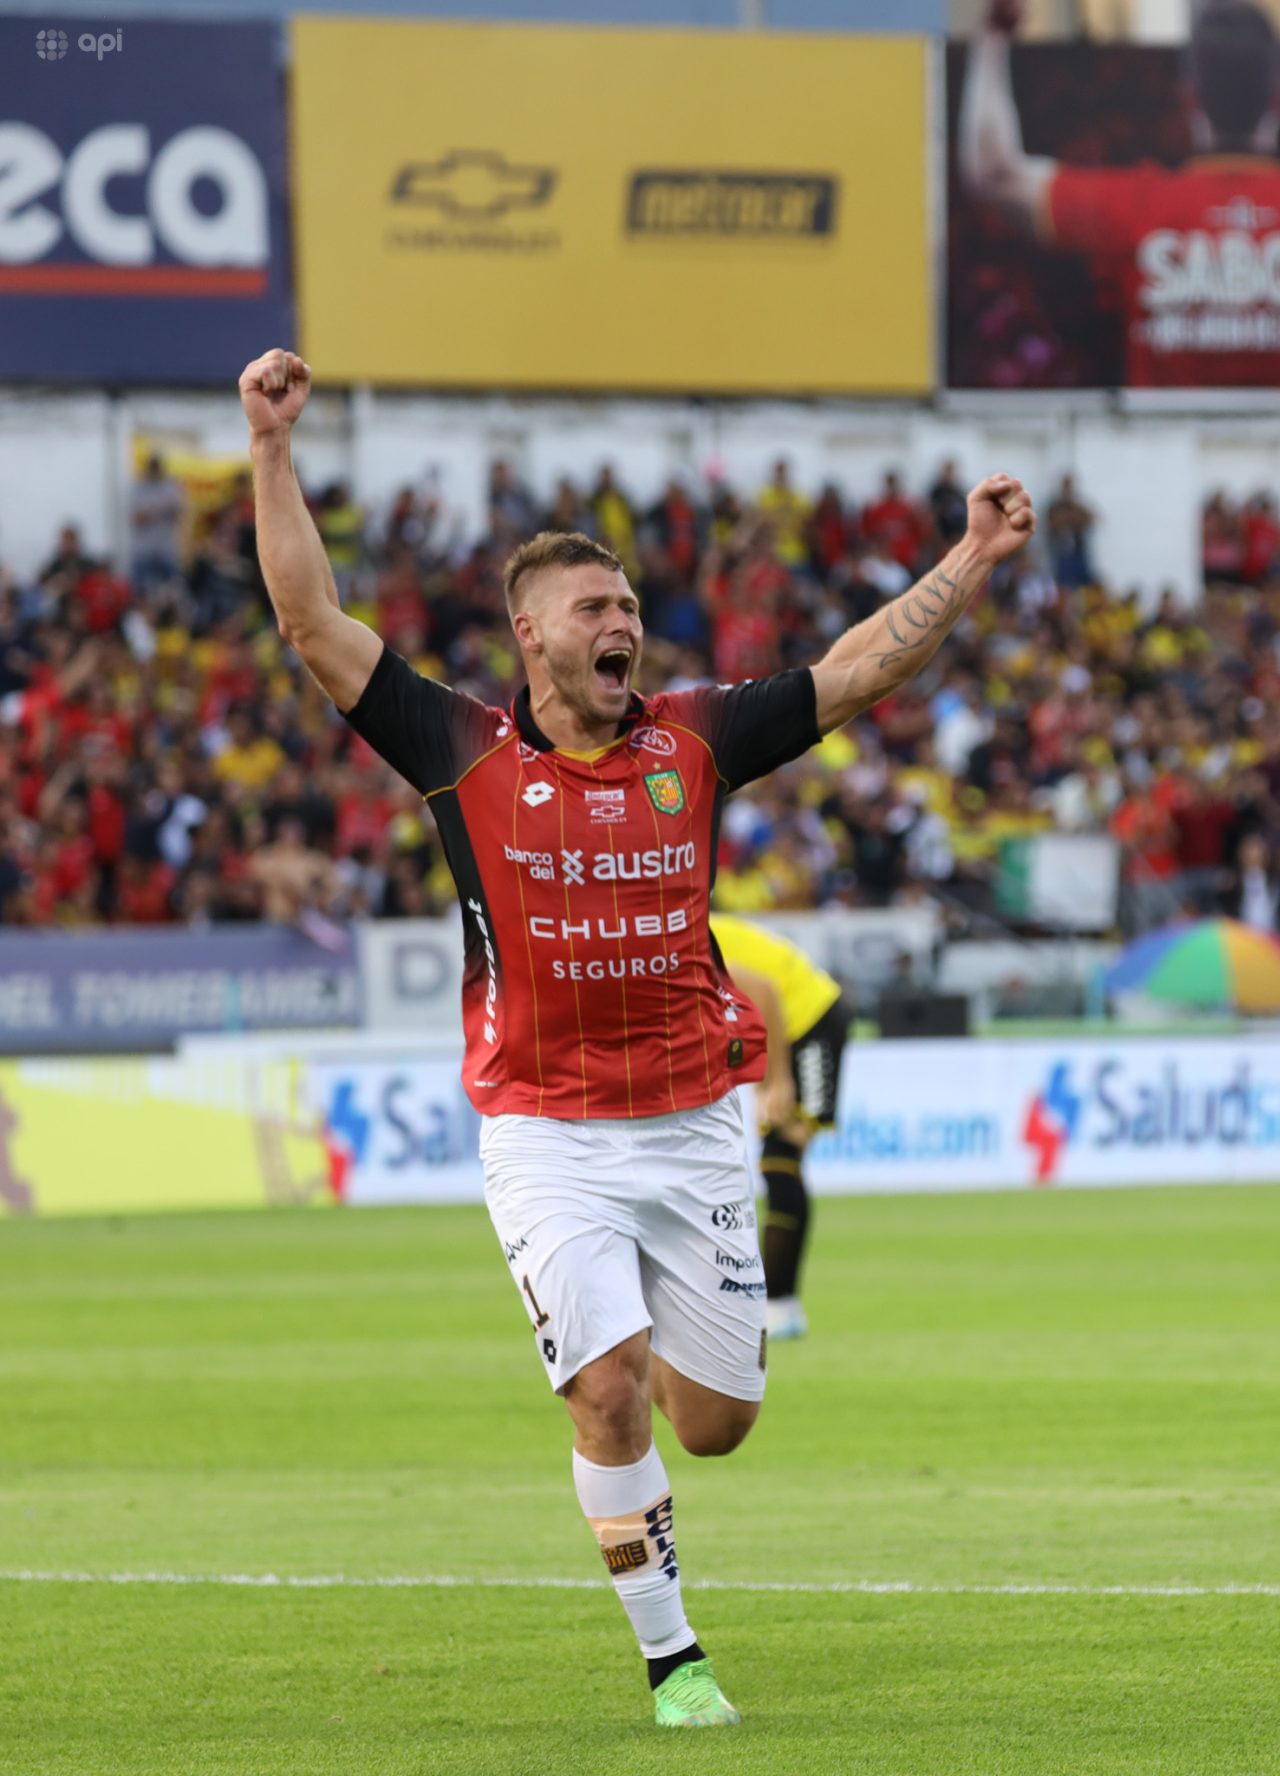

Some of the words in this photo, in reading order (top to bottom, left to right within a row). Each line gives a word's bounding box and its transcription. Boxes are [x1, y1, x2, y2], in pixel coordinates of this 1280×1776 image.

[504, 844, 553, 865] banco
[593, 841, 695, 880] austro
[530, 865, 555, 881] del
[530, 909, 687, 940] CHUBB
[552, 952, 680, 981] SEGUROS
